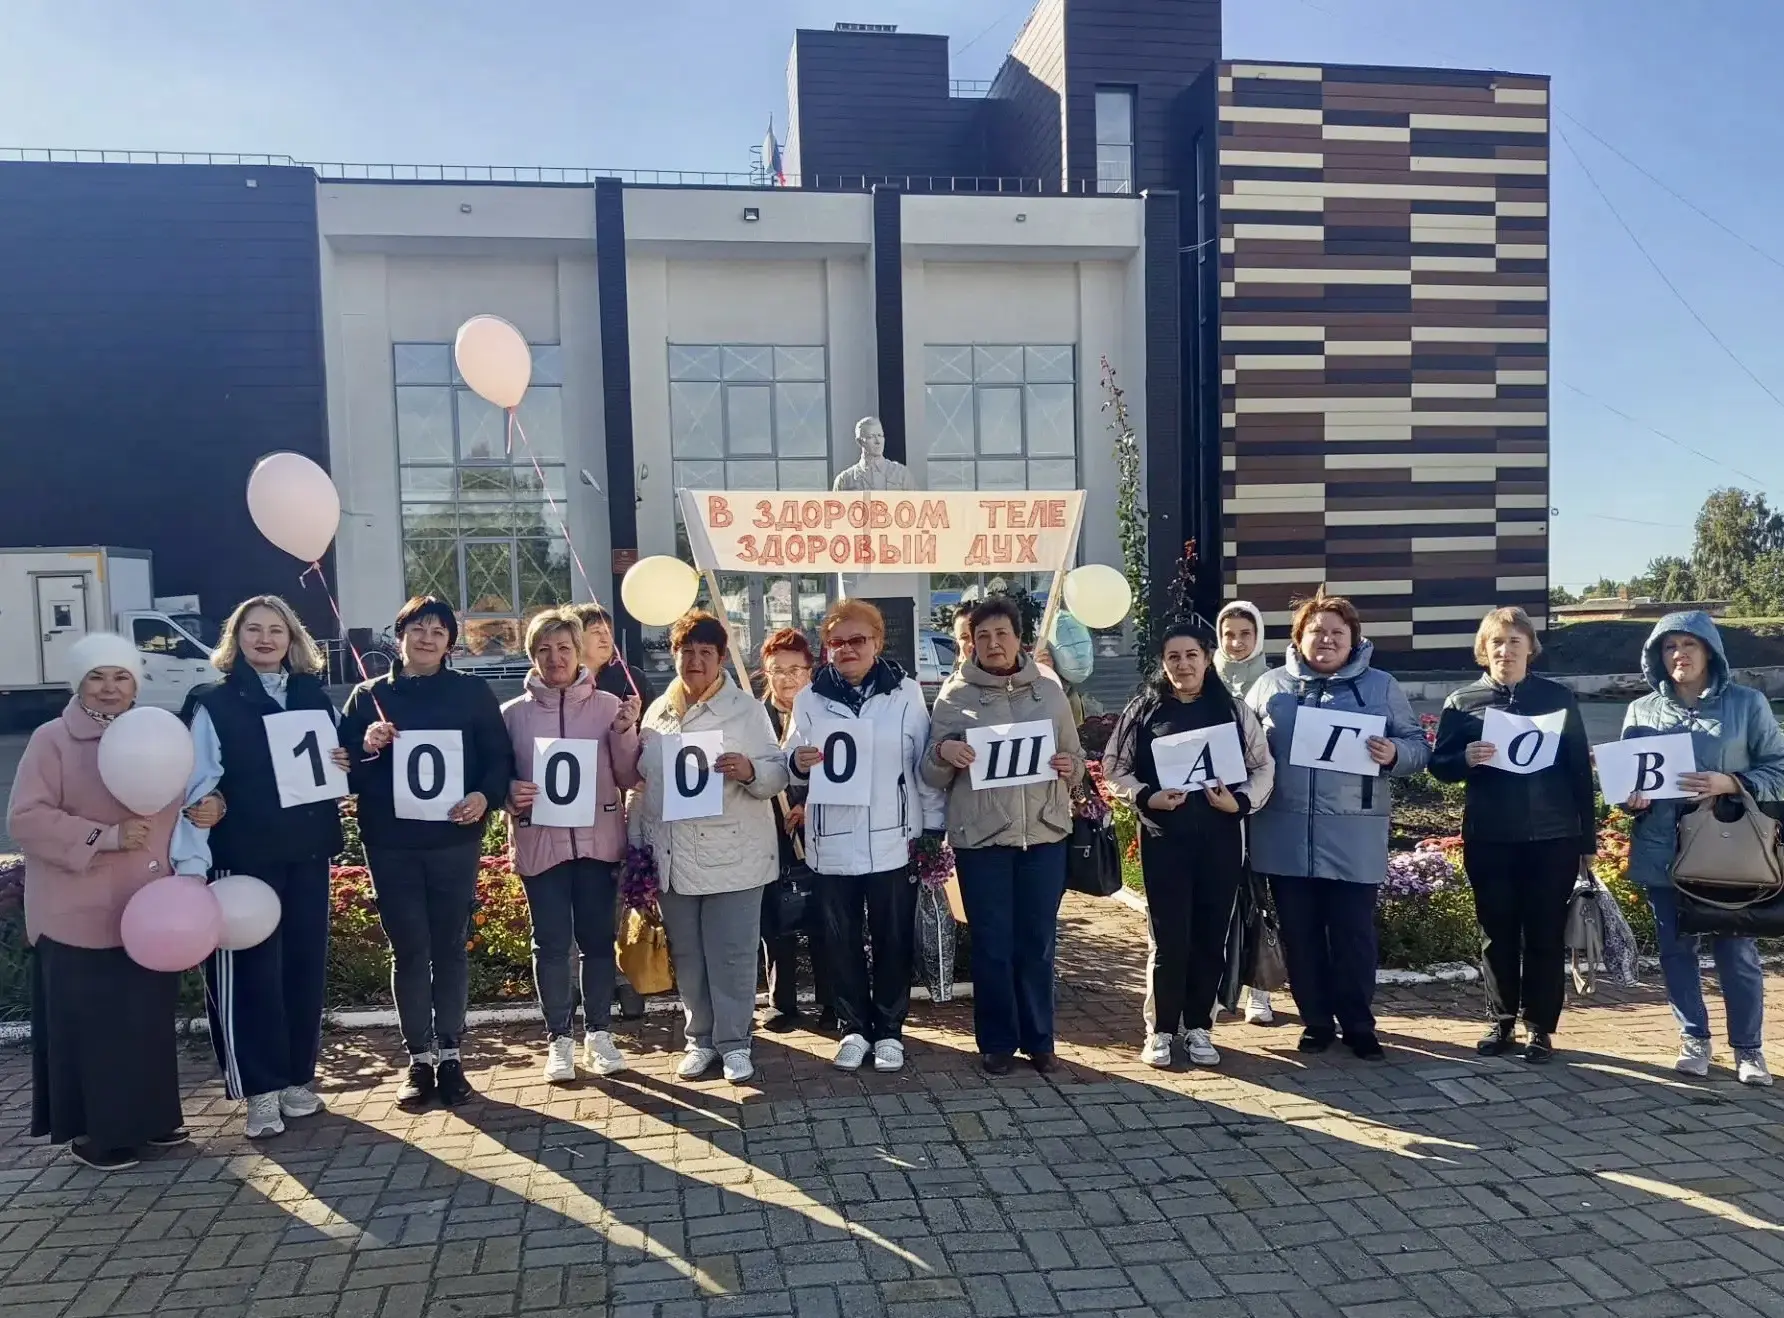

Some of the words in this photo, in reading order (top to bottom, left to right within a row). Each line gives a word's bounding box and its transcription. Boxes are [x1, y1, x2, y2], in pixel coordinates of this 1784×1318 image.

[708, 495, 735, 528] В
[752, 499, 950, 532] ЗДОРОВОМ
[979, 499, 1067, 529] ТЕЛЕ
[735, 530, 937, 566] ЗДОРОВЫЙ
[964, 533, 1039, 566] ДУХ
